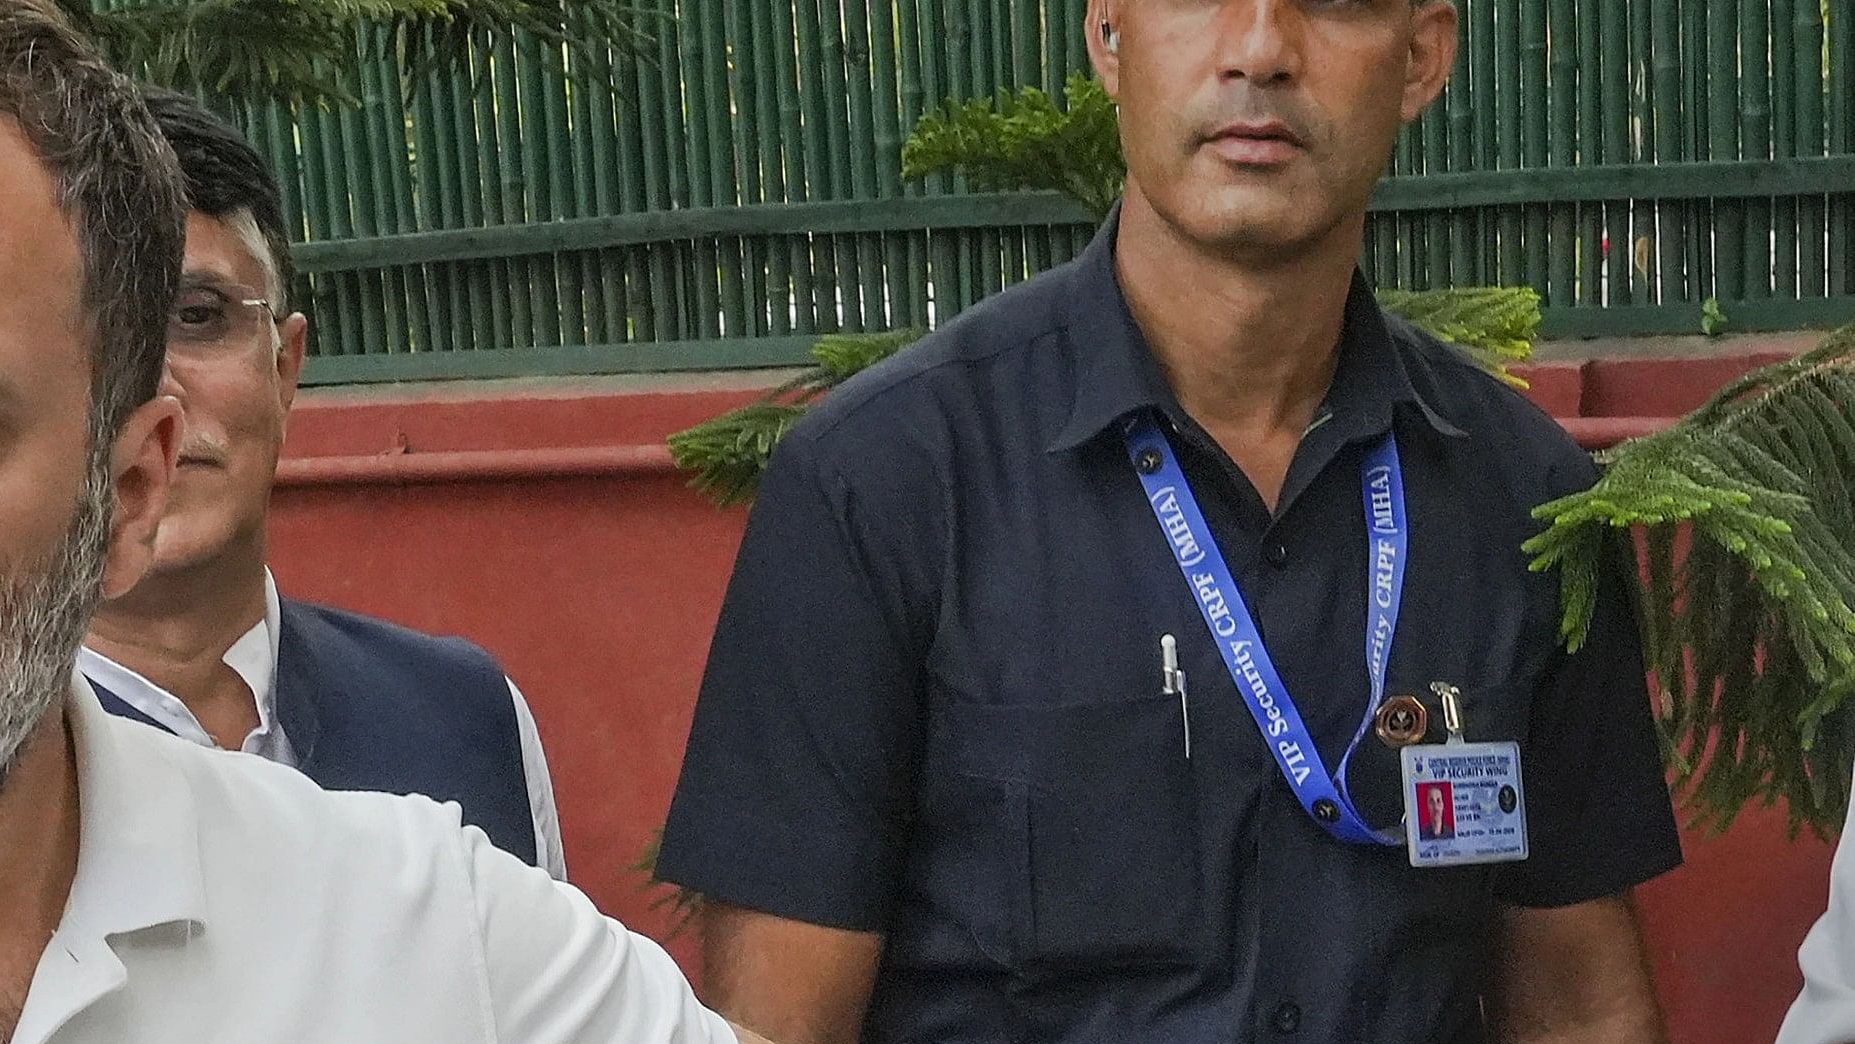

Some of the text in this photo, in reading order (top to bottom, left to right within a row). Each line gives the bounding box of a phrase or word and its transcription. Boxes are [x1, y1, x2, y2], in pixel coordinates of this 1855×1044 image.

[1367, 465, 1398, 534] (MHA)
[1375, 539, 1397, 608] CRPF
[1151, 485, 1312, 788] VIP Security CRPF (MHA)
[1432, 766, 1508, 779] VIP SECURITY WING
